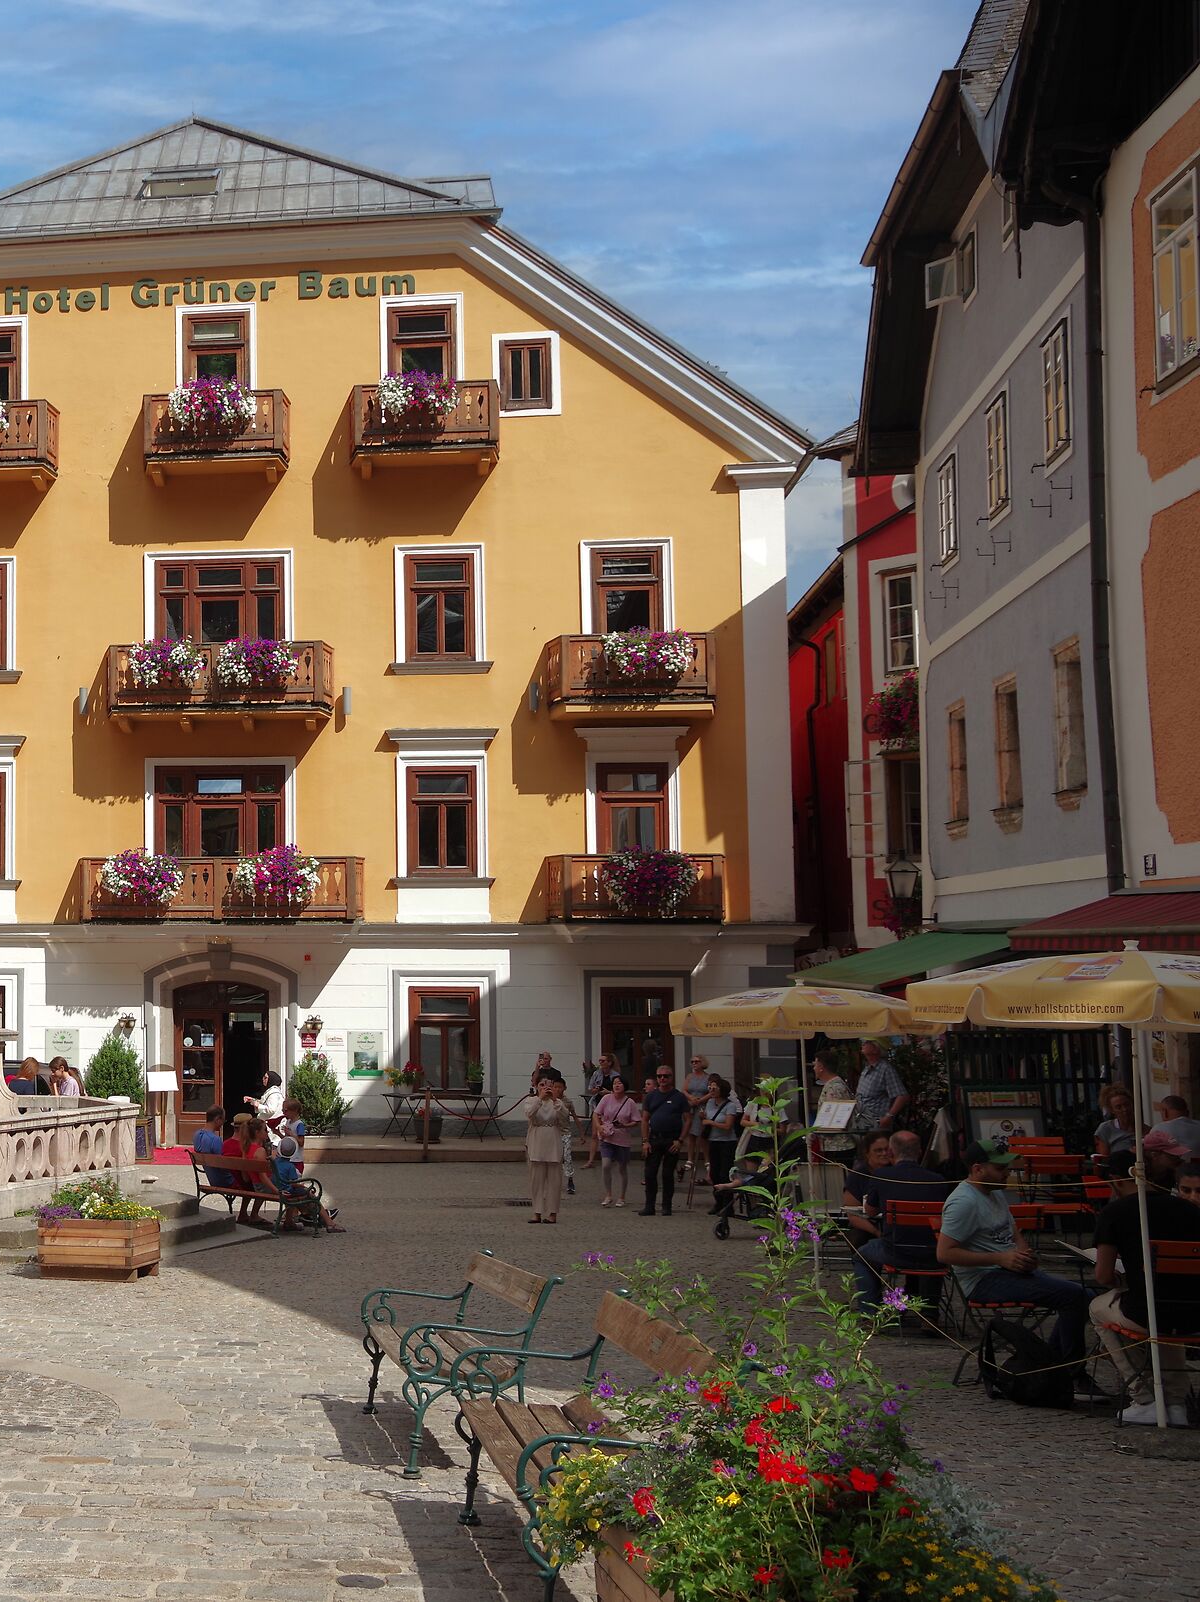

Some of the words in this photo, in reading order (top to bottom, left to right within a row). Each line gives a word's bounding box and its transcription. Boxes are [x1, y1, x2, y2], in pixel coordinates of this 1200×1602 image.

[4, 282, 110, 315] Hotel
[131, 276, 276, 308] Grüner
[297, 271, 417, 300] Baum
[1008, 1003, 1124, 1014] www.hallstattbier.com
